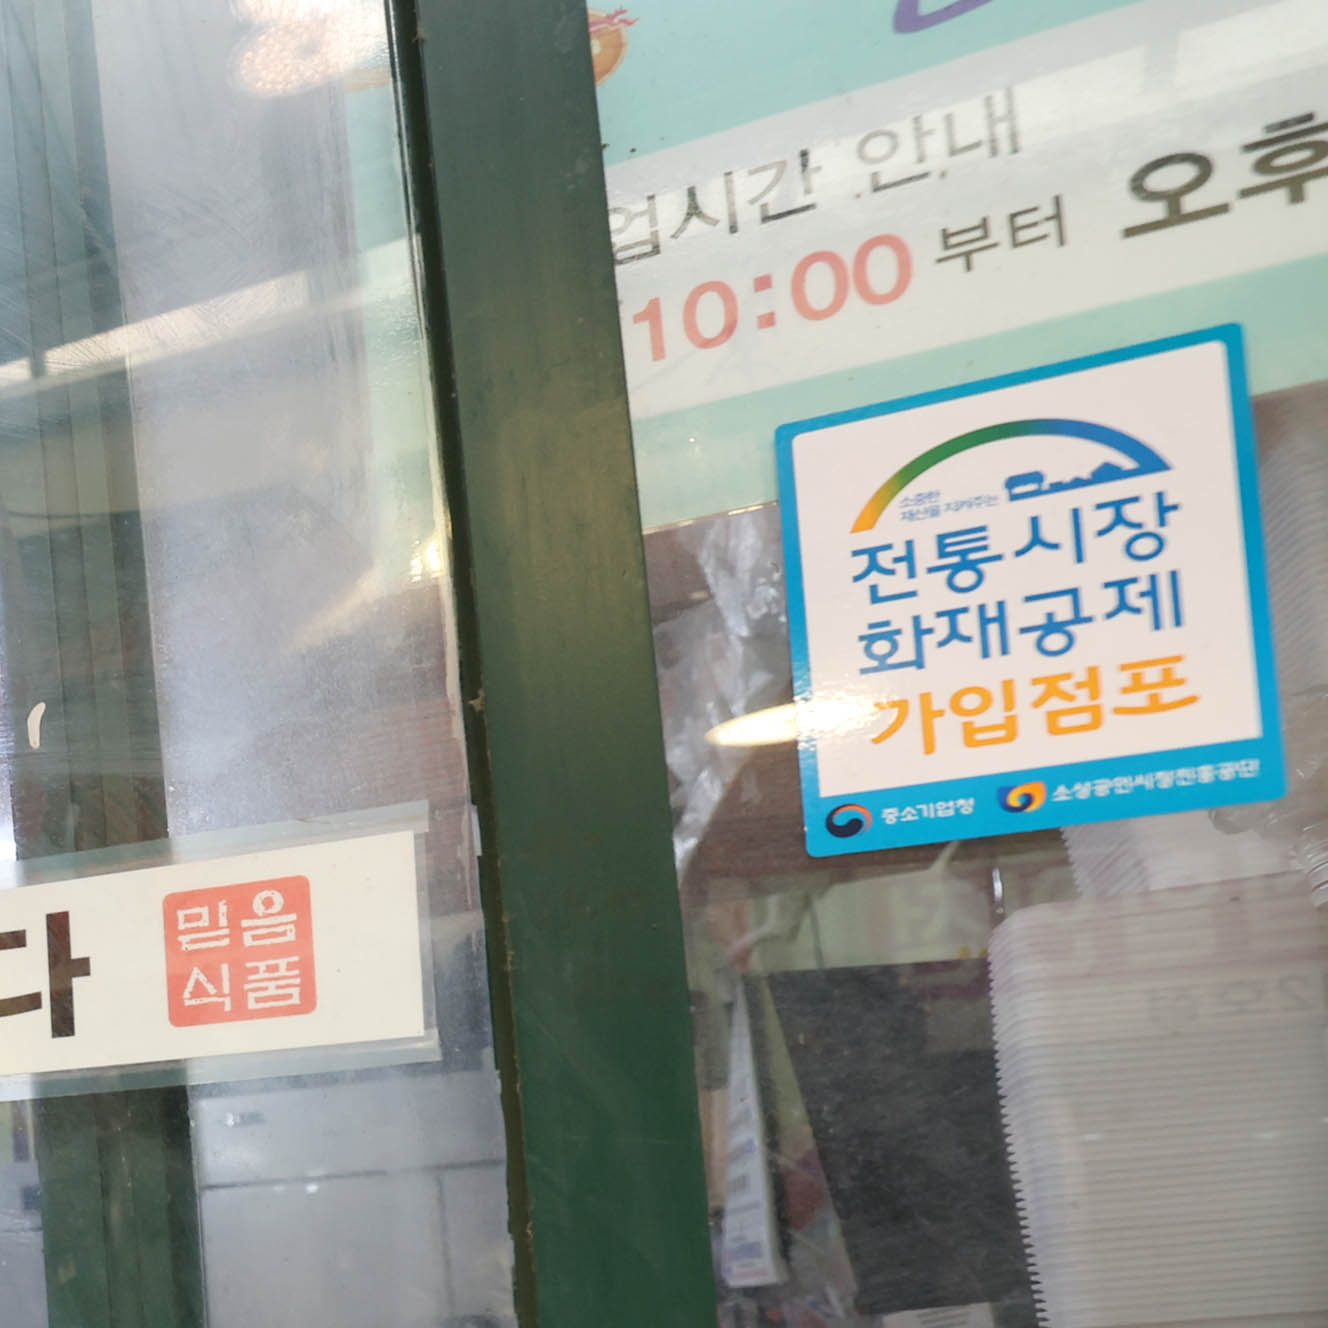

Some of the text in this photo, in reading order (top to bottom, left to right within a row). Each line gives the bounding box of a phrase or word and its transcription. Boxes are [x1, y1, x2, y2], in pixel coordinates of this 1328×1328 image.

[608, 86, 1020, 266] 업시간 안내
[633, 112, 1328, 362] 10:00 부터 오후
[850, 490, 1181, 605] 전통시장
[857, 569, 1186, 676] 화재공제
[870, 654, 1201, 756] 가입점포
[881, 796, 976, 825] 중소기업청
[176, 889, 296, 952] 믿음
[181, 954, 303, 1014] 식품
